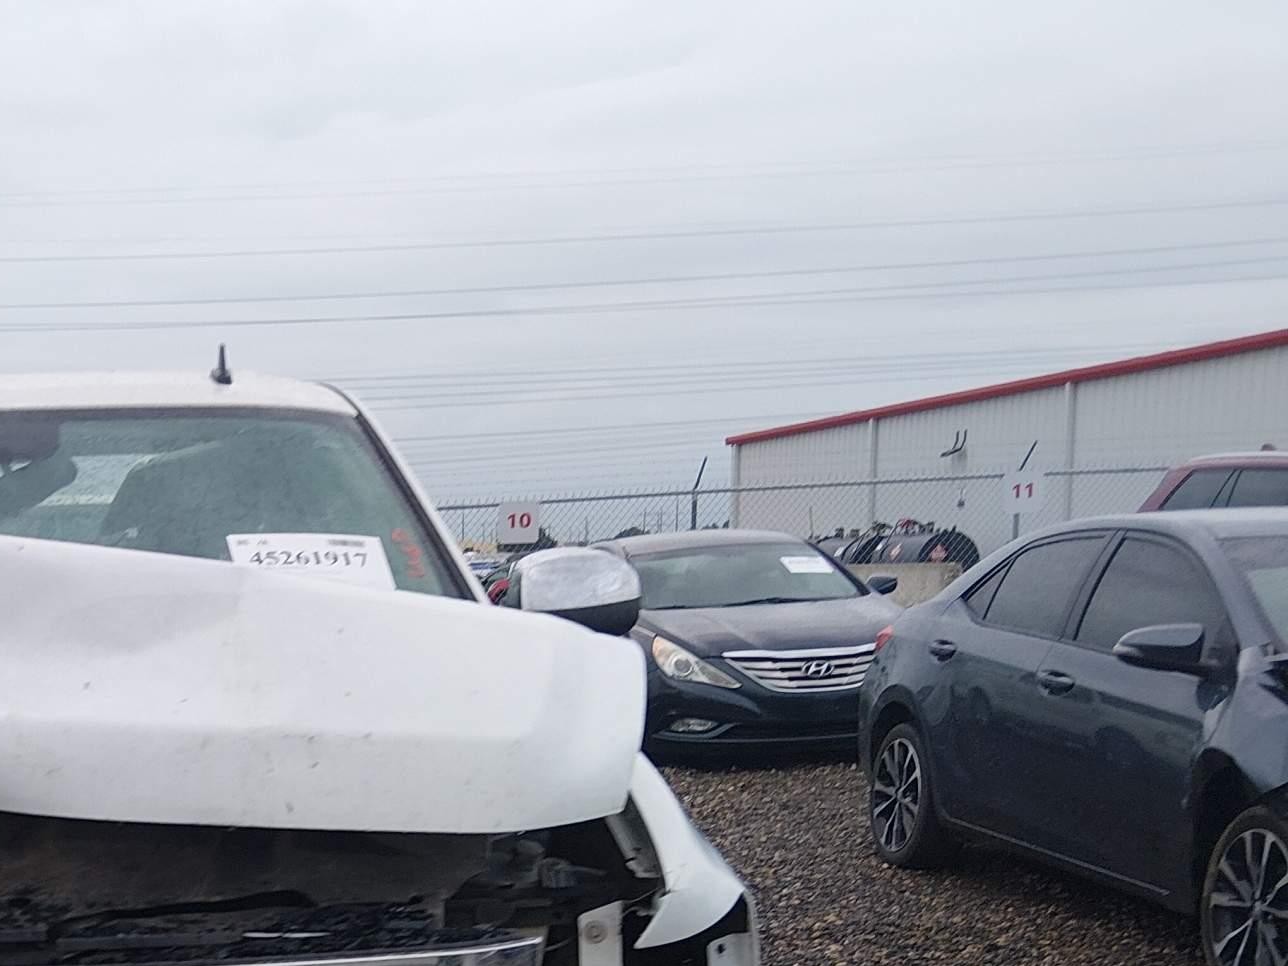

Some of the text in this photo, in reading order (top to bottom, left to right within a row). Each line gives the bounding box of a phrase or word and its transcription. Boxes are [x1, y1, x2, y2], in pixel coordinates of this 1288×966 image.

[1012, 482, 1033, 498] 11
[507, 512, 531, 528] 10
[249, 550, 368, 568] 45261917
